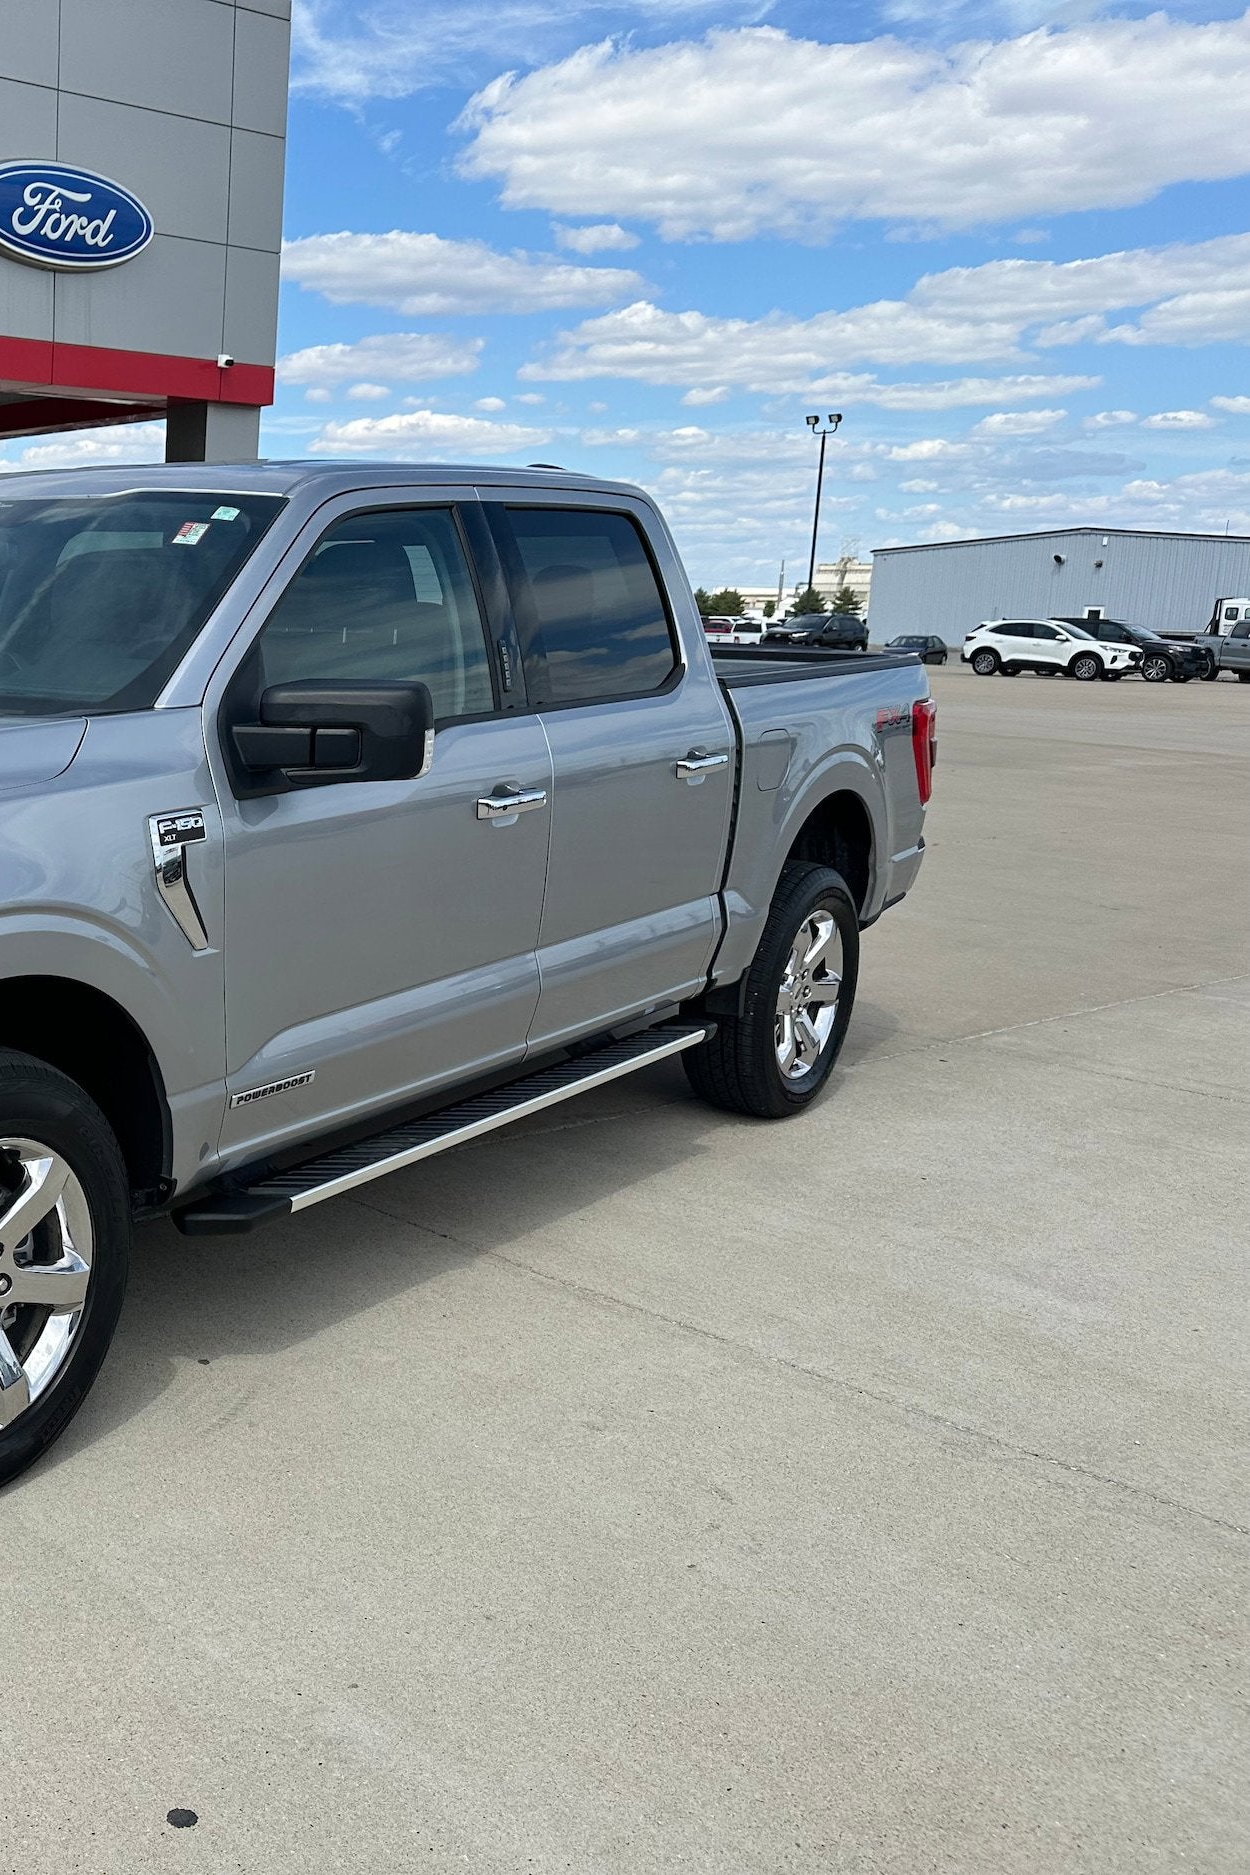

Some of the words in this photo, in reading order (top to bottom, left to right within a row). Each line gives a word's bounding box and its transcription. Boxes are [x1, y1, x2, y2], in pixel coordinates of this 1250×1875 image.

[12, 182, 117, 248] Ford
[877, 703, 910, 734] FX4
[159, 816, 204, 834] F-150
[163, 833, 177, 842] XLT
[236, 1074, 312, 1105] POWERBOOST
